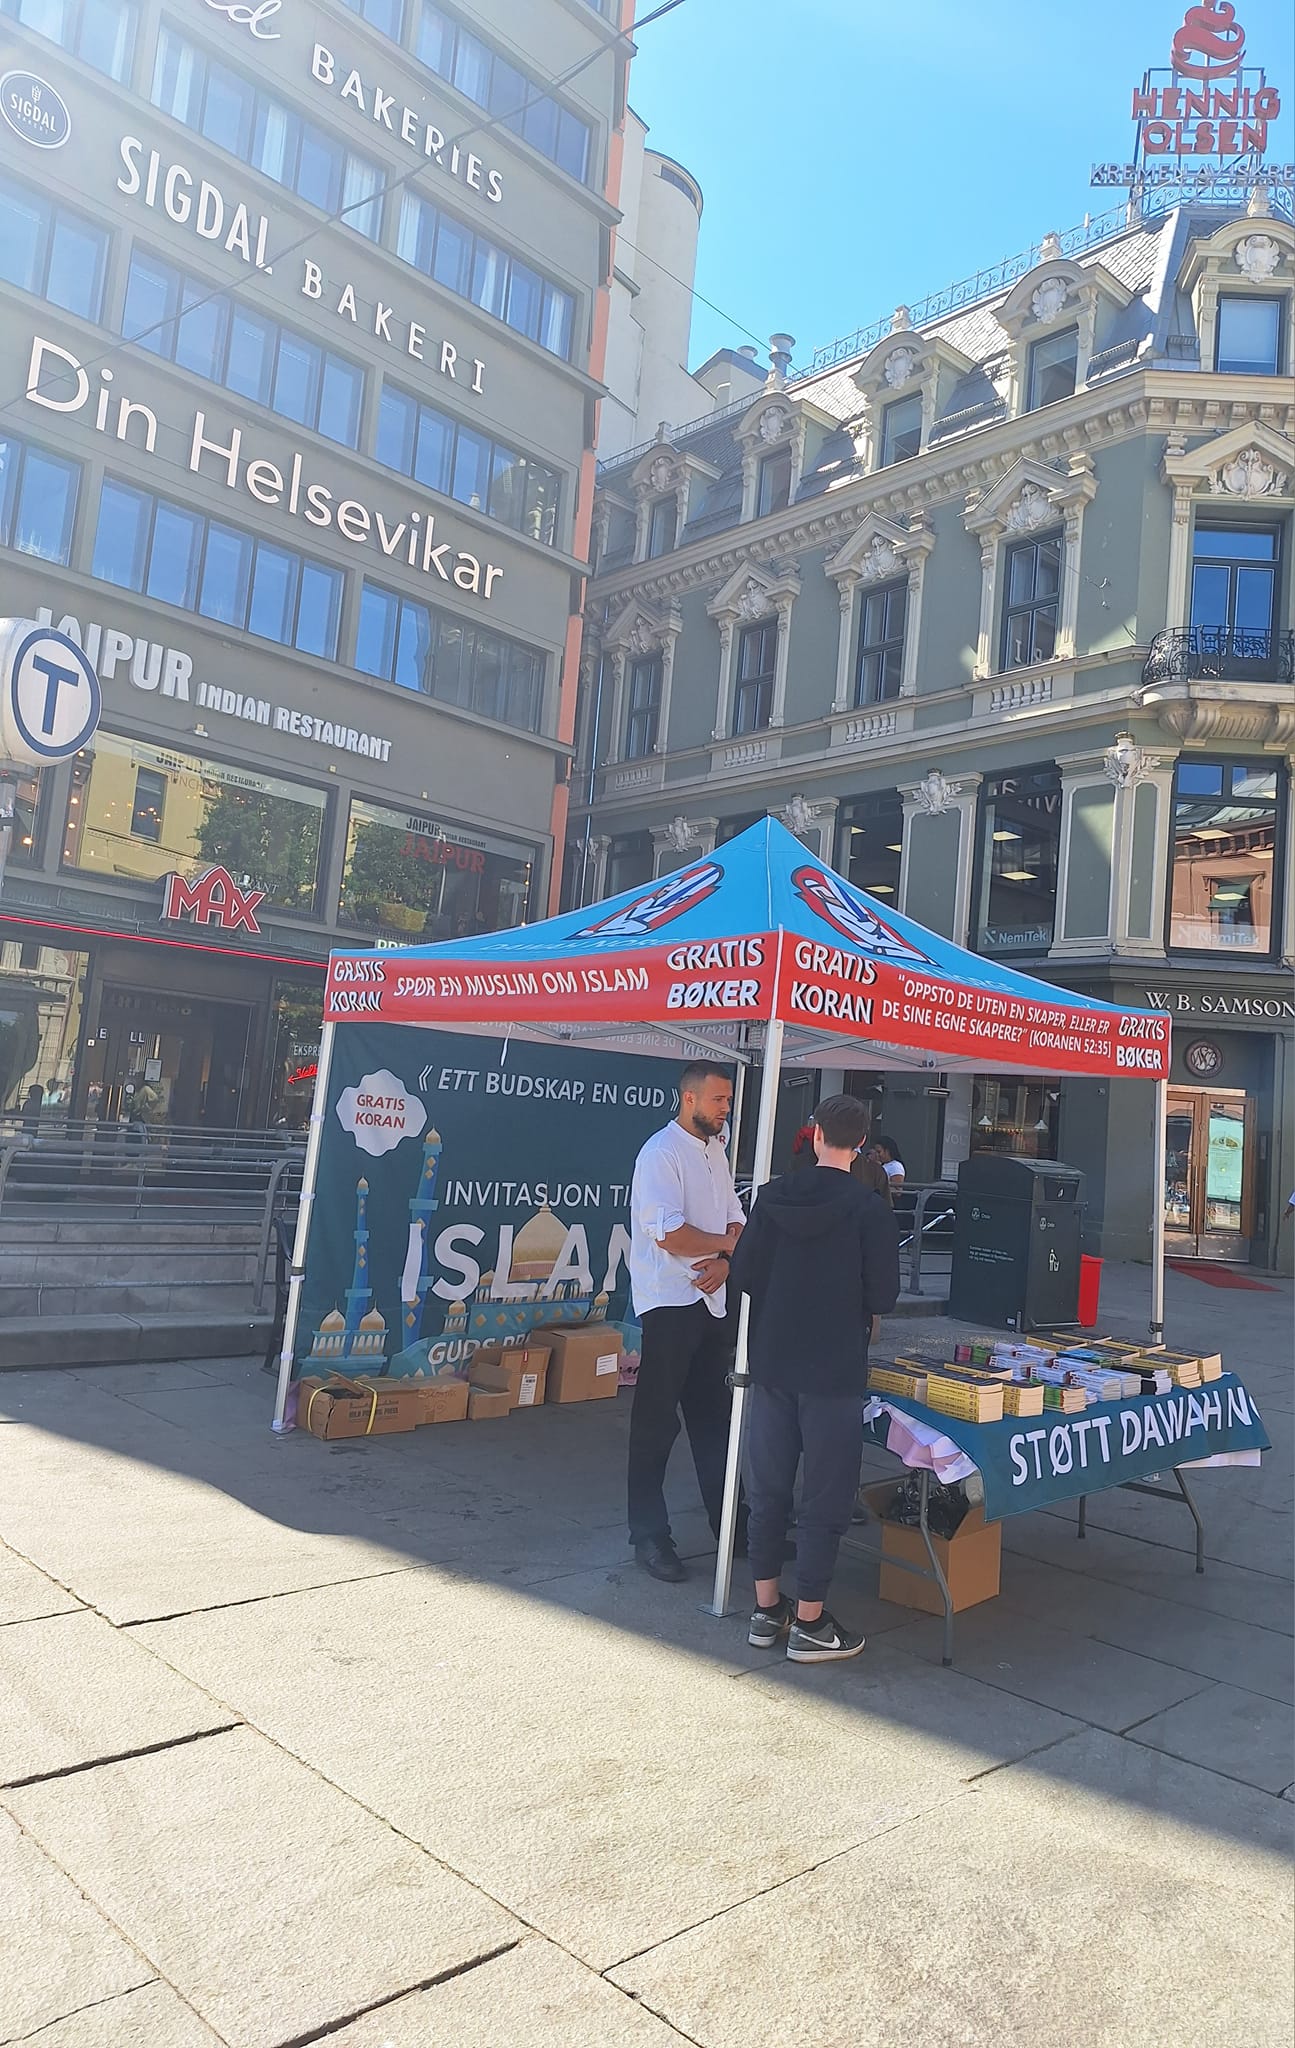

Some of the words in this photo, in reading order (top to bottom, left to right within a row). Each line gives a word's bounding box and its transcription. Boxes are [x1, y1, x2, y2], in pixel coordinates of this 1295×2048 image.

[10, 93, 57, 133] SIGDAL
[1132, 87, 1280, 120] HENNIG
[311, 42, 503, 204] BAKERIES
[1142, 122, 1268, 154] OLSEN
[1091, 163, 1187, 184] KREMEN
[117, 135, 273, 275] SIGDAL
[302, 258, 486, 395] BAKERI
[25, 335, 158, 453] Din
[188, 410, 503, 600] Helsevikar
[33, 655, 79, 735] T
[197, 682, 271, 726] INDIAN
[272, 706, 392, 762] RESTAURANT
[400, 833, 487, 875] JAIPUR
[162, 865, 266, 934] MAX
[999, 927, 1047, 945] NemiTek
[334, 960, 387, 982] GRATIS
[666, 938, 765, 971] GRATIS
[795, 941, 878, 986] GRATIS
[393, 976, 437, 997] SPØR
[440, 976, 463, 997] EN
[466, 973, 540, 997] MUSLIM
[541, 970, 578, 994] OM
[581, 967, 650, 993] ISLAM
[666, 979, 761, 1009] BØKER
[329, 991, 383, 1012] KORAN
[791, 981, 875, 1025] KORAN
[957, 991, 974, 1010] DE
[976, 996, 1007, 1017] UTEN
[1009, 1004, 1025, 1020] EN
[1026, 1006, 1067, 1030] SKAPER,
[1069, 1016, 1097, 1034] ELLER
[1097, 1020, 1111, 1035] ER
[1146, 991, 1171, 1010] W.
[1176, 993, 1196, 1012] B.
[1200, 995, 1295, 1018] SAMSON
[882, 999, 900, 1020] DE
[903, 1004, 932, 1026] SINE
[934, 1011, 967, 1033] EGNE
[1029, 1029, 1082, 1053] [KORANEN
[1083, 1040, 1112, 1059] 52:35]
[1118, 1015, 1166, 1041] GRATIS
[1116, 1045, 1163, 1070] BØKER
[356, 1093, 406, 1112] GRATIS
[438, 1068, 480, 1092] ETT
[485, 1072, 585, 1105] BUDSKAP,
[591, 1082, 618, 1105] EN
[623, 1087, 666, 1108] GUD
[355, 1112, 406, 1130] KORAN
[444, 1180, 601, 1208] INVITASJON
[609, 1184, 633, 1208] TI
[1009, 1415, 1113, 1486] STØTT
[1119, 1390, 1223, 1456] DAWAH
[1226, 1386, 1263, 1429] N
